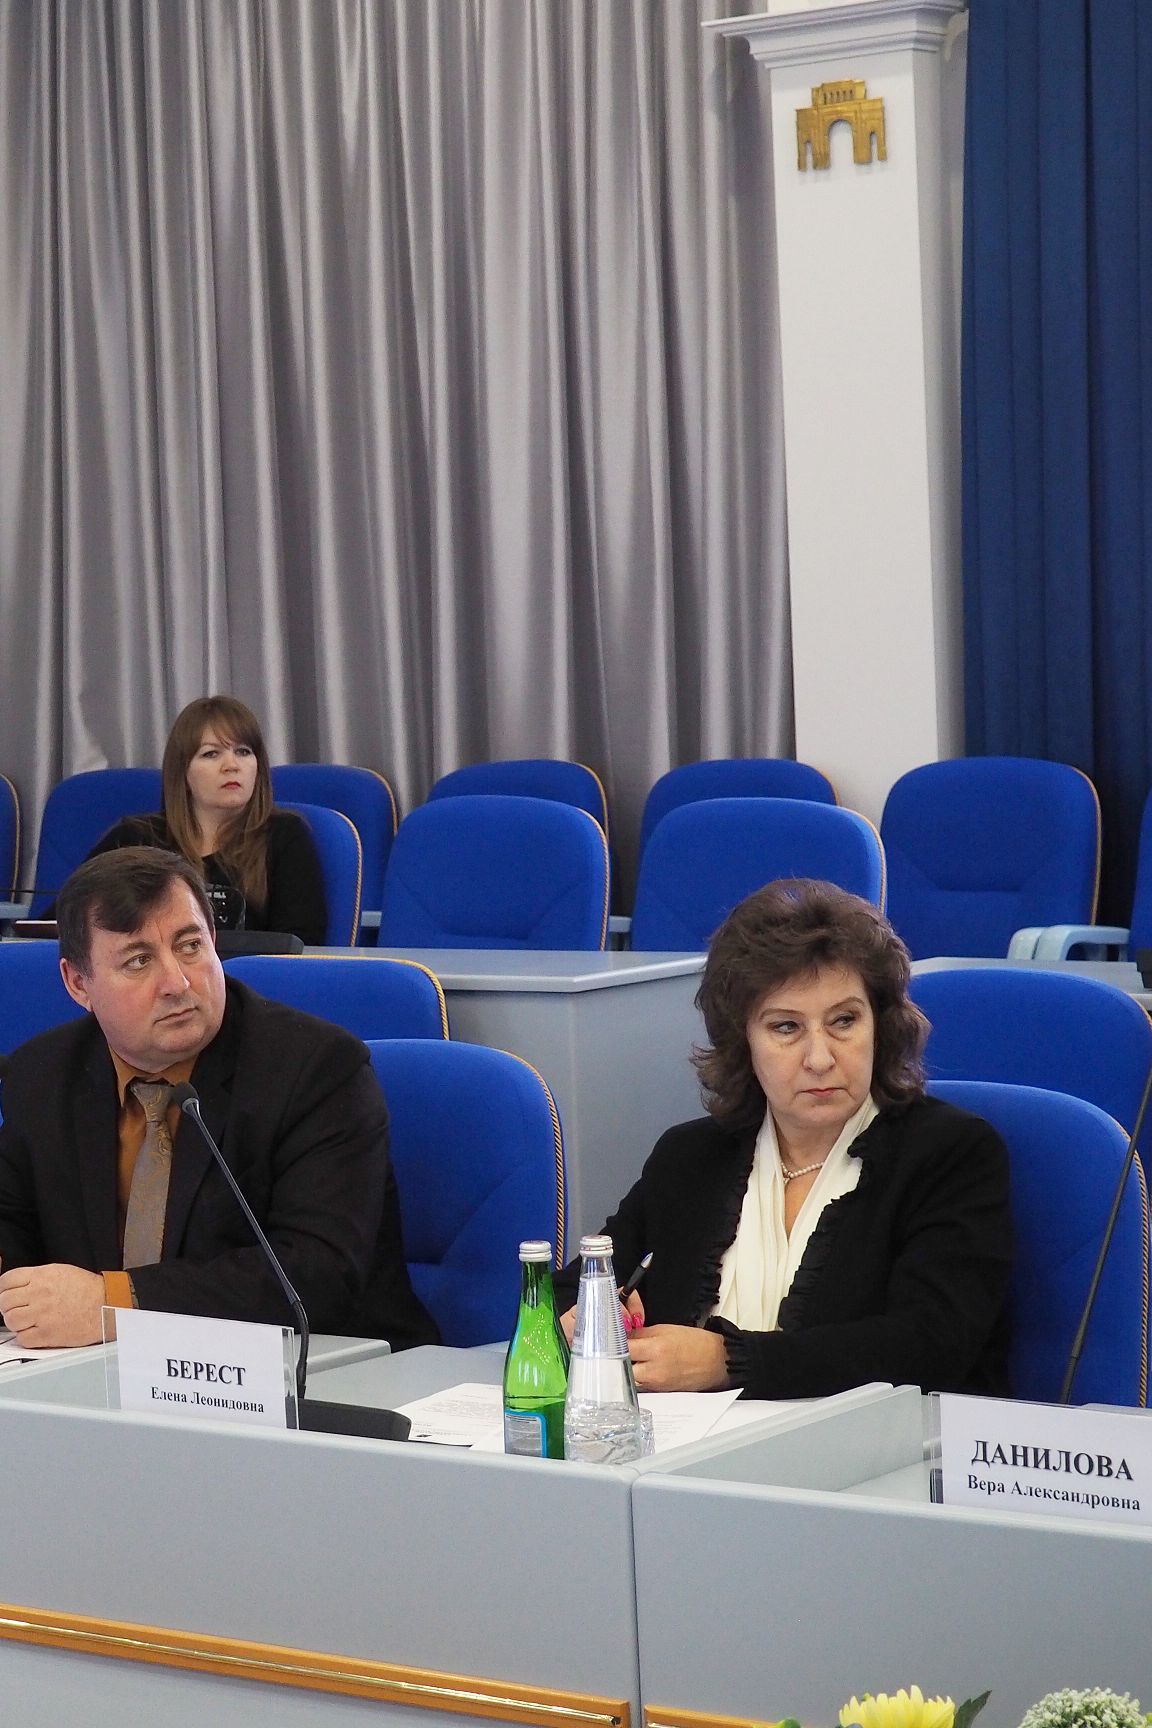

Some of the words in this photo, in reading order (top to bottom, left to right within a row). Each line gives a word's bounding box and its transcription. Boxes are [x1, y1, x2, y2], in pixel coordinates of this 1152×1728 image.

[166, 1358, 246, 1386] БЕРЕСТ
[151, 1386, 188, 1403] Елена
[190, 1391, 265, 1413] Леонидовна
[970, 1439, 1135, 1482] ДАНИЛОВА
[967, 1474, 1006, 1496] Вера
[1010, 1480, 1141, 1511] Александровна
